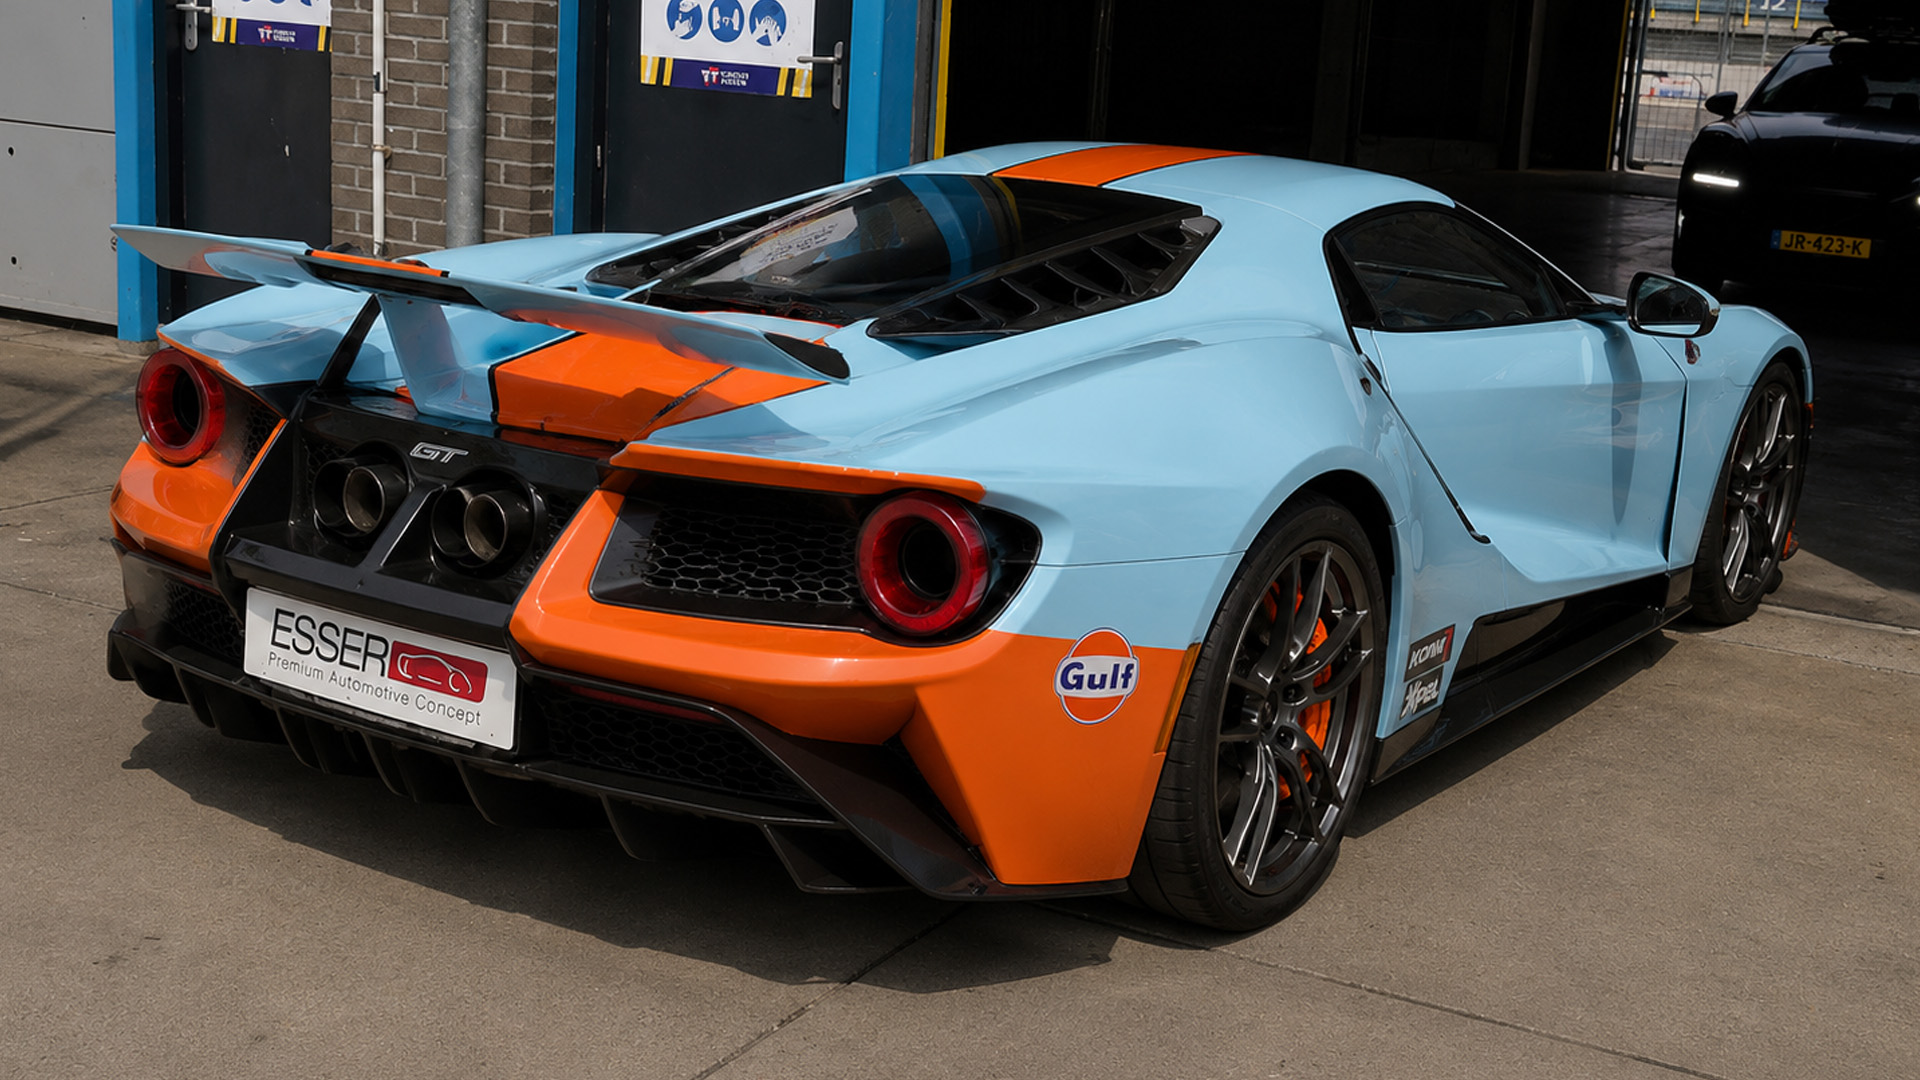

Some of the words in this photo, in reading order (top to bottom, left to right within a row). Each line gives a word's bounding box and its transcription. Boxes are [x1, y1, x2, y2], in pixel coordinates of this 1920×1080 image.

[1784, 233, 1864, 255] JR-423-K
[409, 441, 469, 463] GT
[270, 608, 388, 677] ESSER
[268, 652, 324, 681] Premium
[328, 672, 409, 706] Automotive
[415, 694, 481, 726] Concept
[1060, 661, 1134, 690] Gulf
